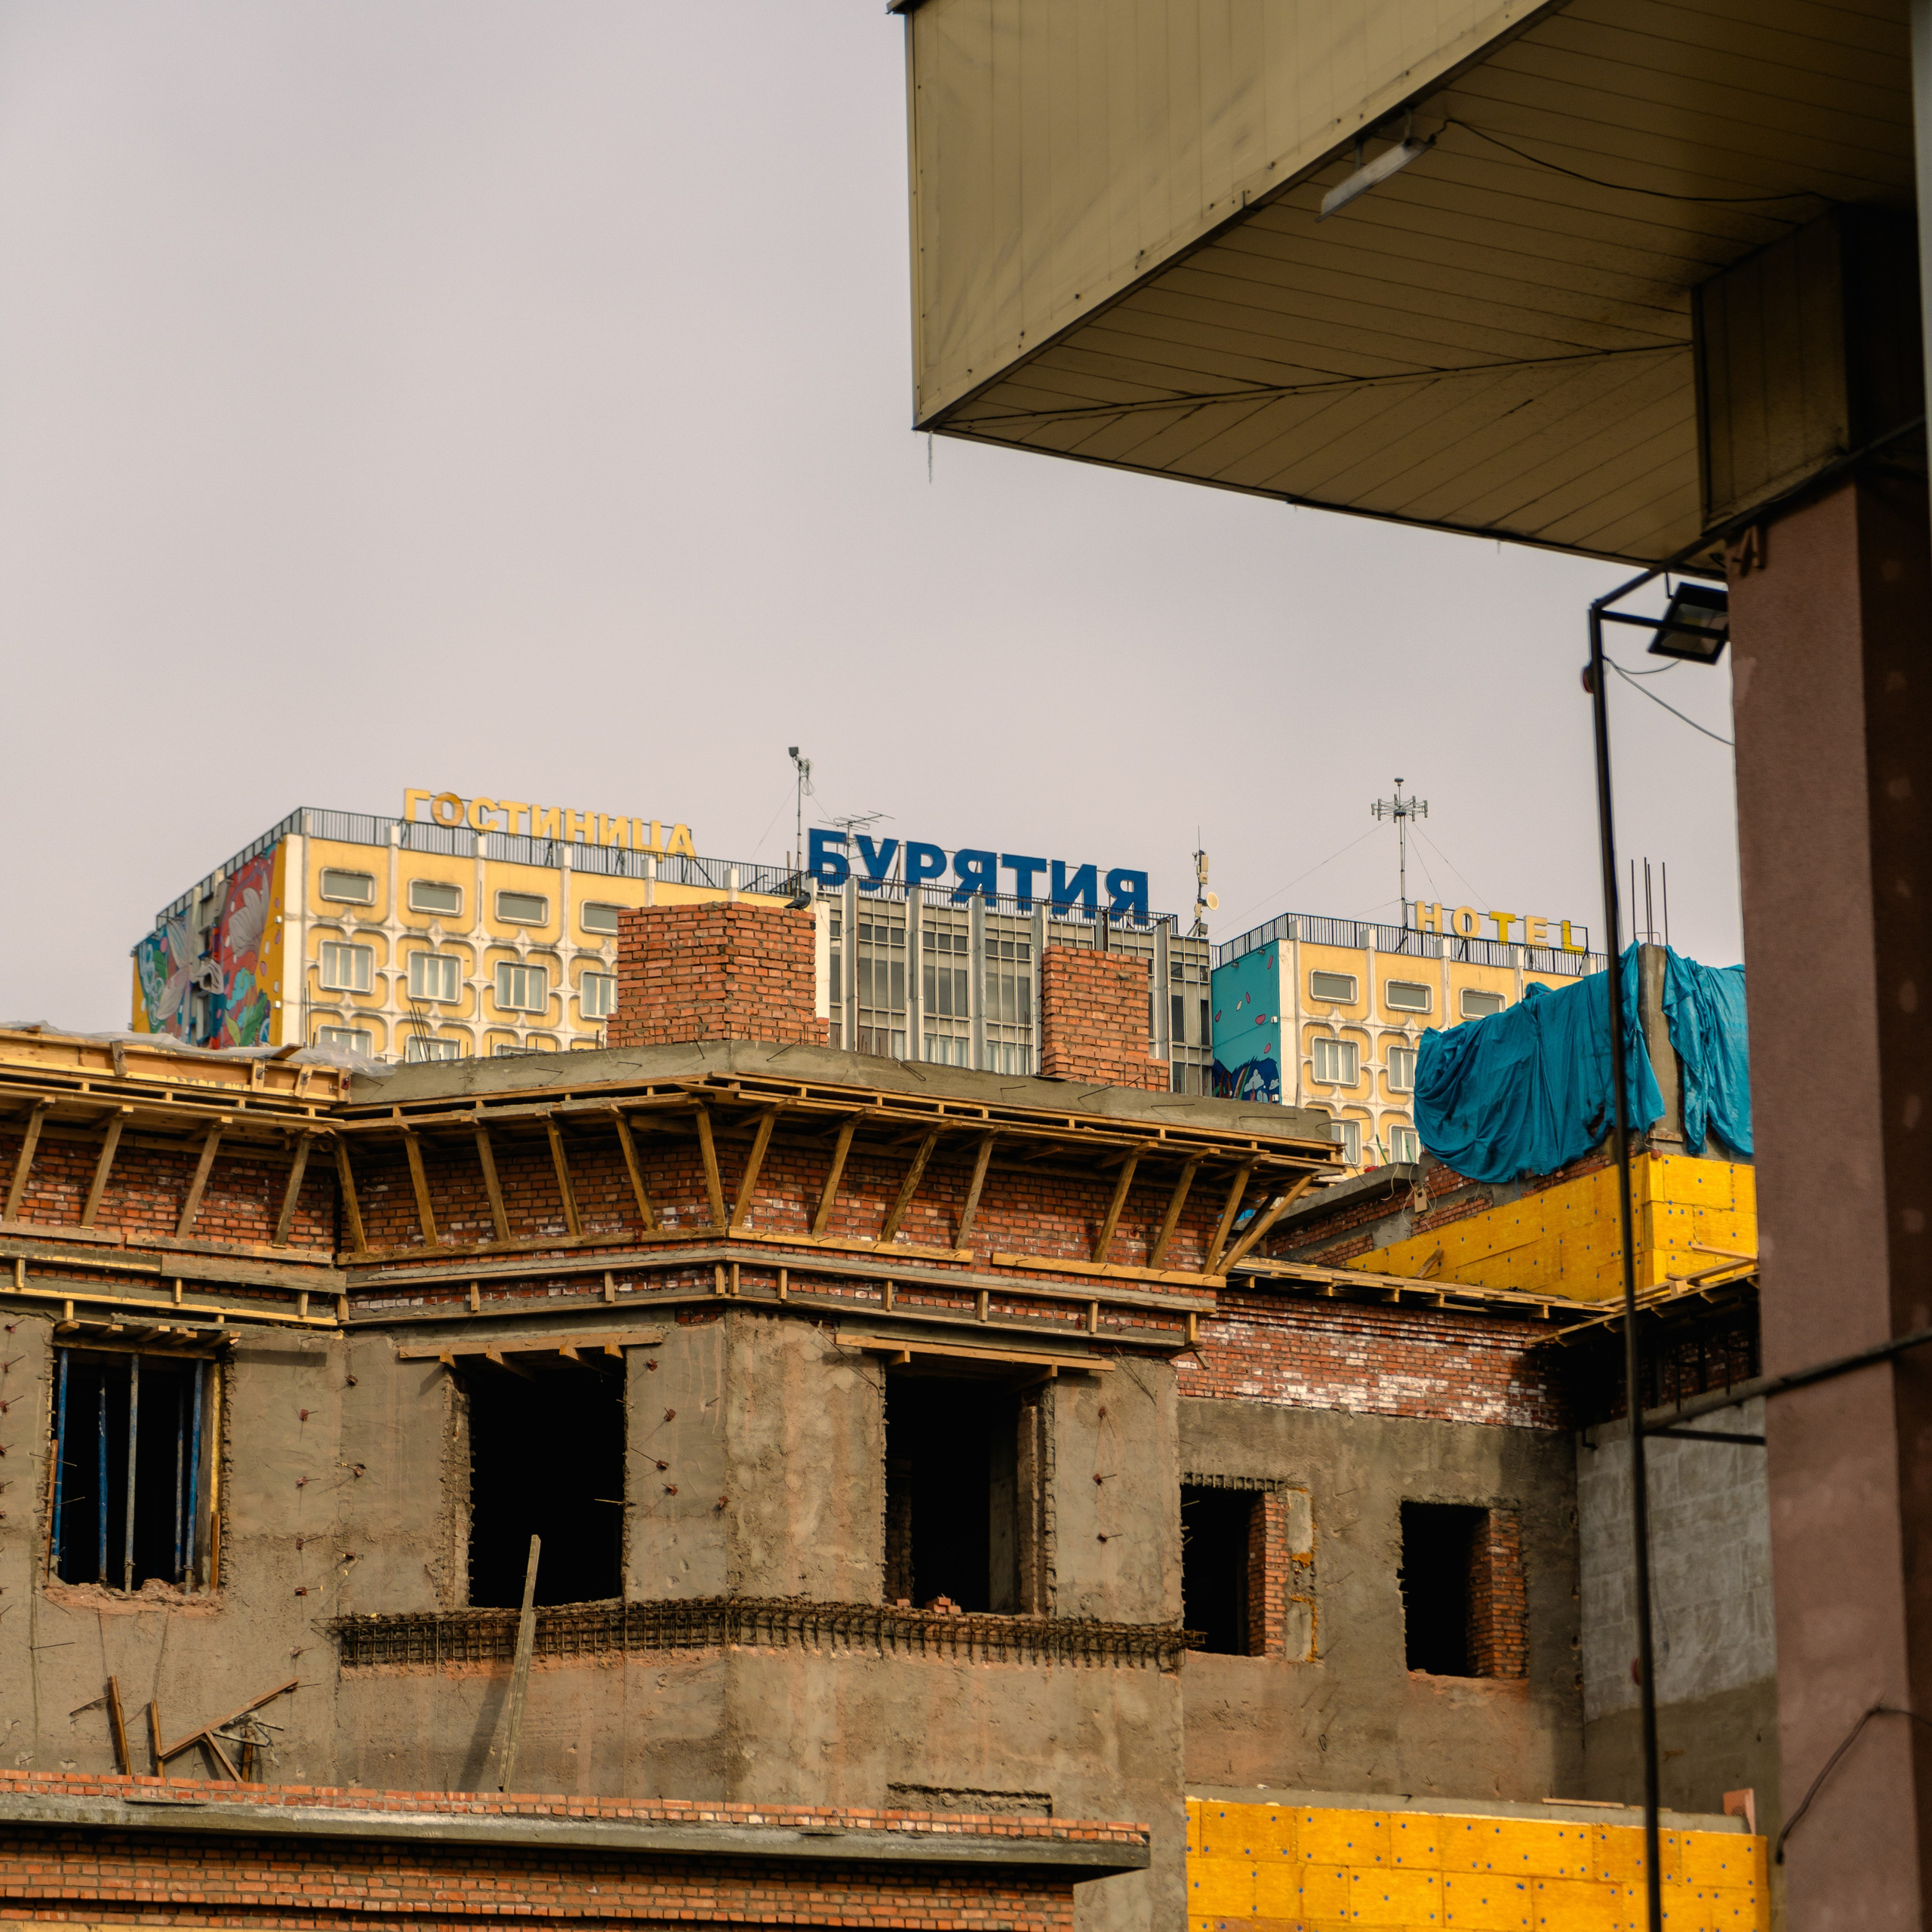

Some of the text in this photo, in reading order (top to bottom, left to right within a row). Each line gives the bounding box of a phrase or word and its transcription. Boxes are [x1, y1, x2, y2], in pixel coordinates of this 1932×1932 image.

[404, 788, 697, 863] ГОСТИНИЦА
[808, 828, 1149, 926] БУРЯТИЯ
[1414, 900, 1584, 954] HOTEL
